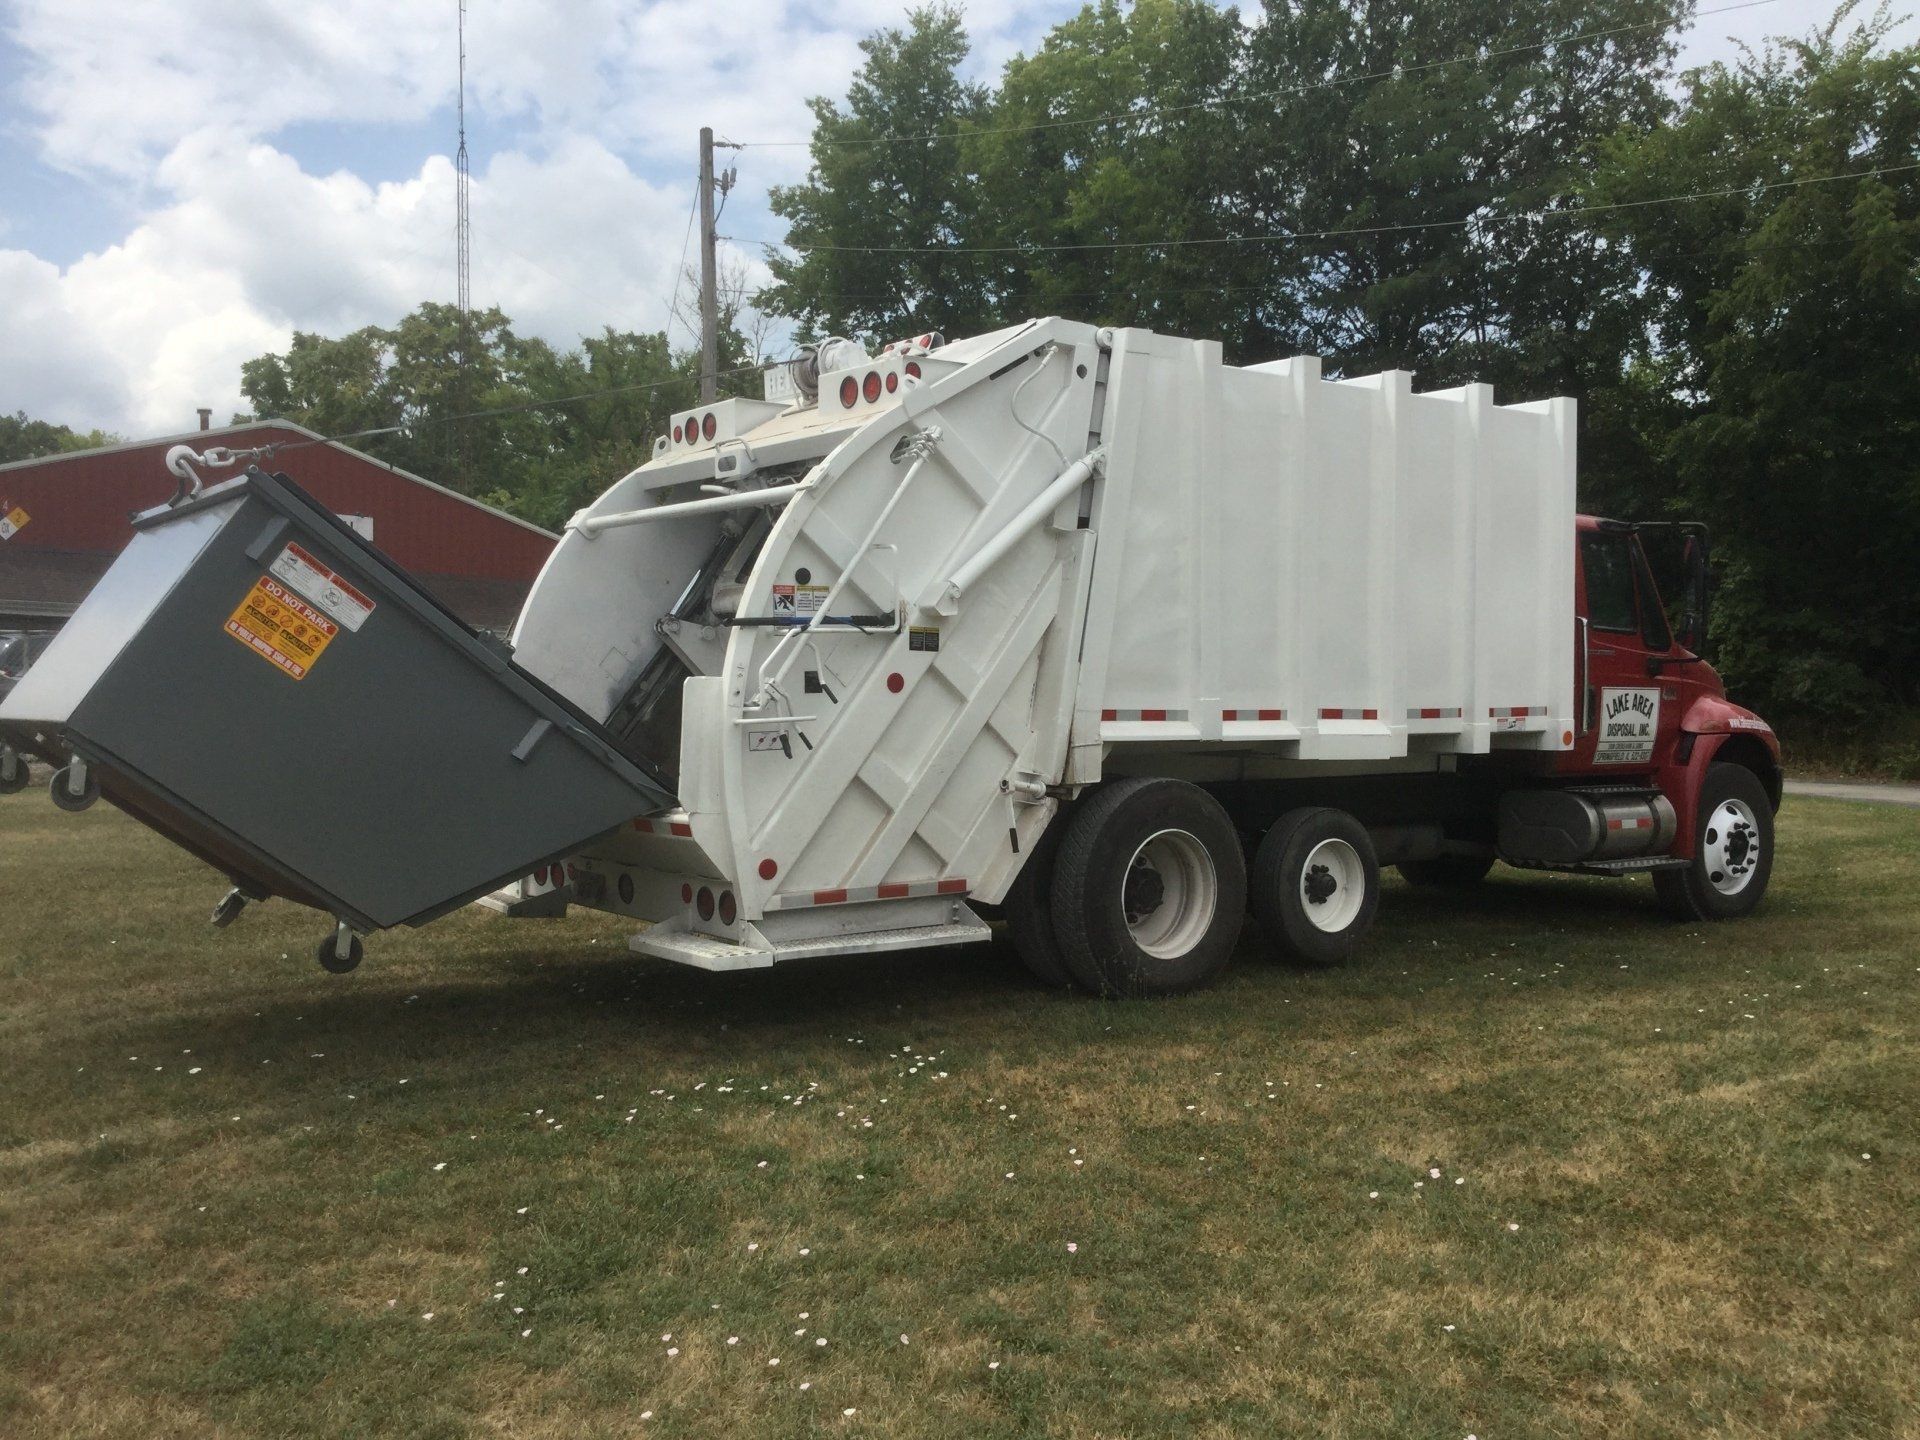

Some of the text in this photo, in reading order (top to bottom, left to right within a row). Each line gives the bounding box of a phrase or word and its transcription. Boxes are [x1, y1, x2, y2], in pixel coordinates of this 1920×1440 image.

[266, 582, 282, 597] DO
[282, 594, 304, 611] NOT
[304, 608, 332, 631] PARK
[1606, 693, 1654, 719] LAKE AREA
[1607, 723, 1650, 737] DISPOSAL, INC.
